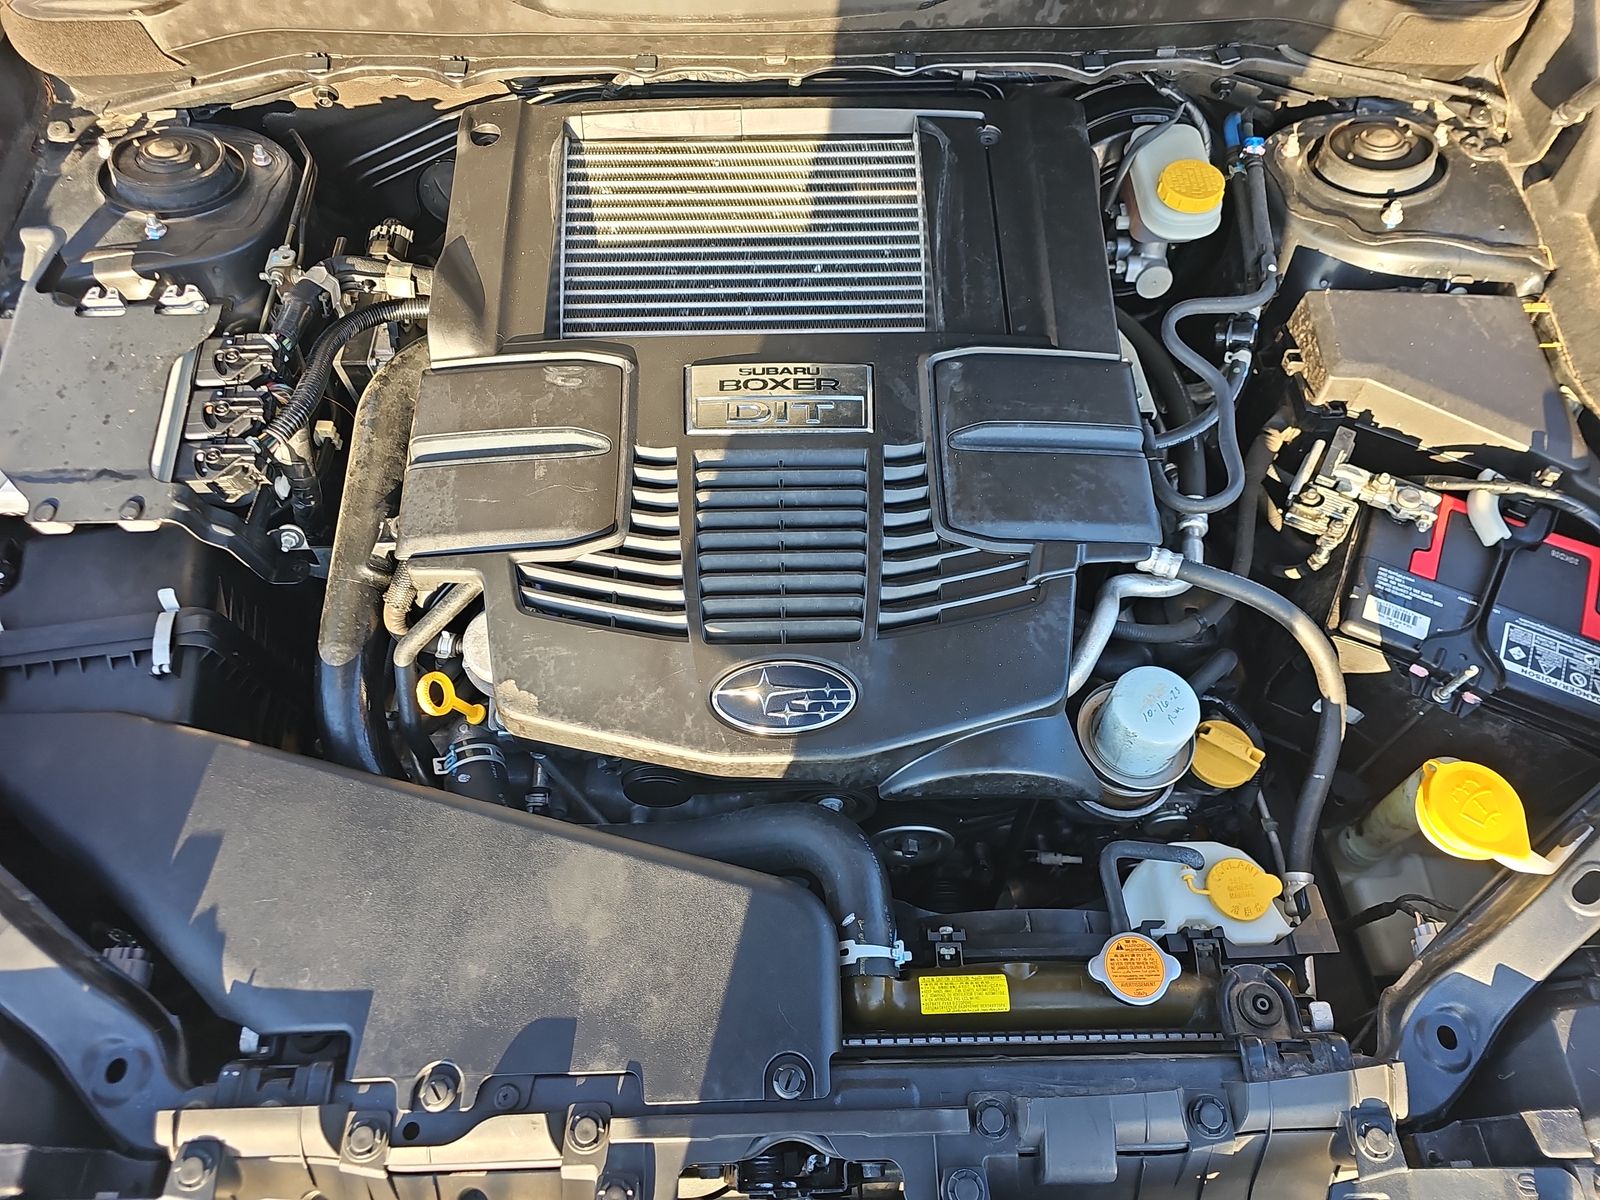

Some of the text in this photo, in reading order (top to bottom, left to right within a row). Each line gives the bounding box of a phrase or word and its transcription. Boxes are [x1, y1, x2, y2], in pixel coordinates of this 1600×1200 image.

[738, 367, 821, 376] SUBARU
[718, 378, 841, 392] BOXER
[726, 401, 835, 425] DIT
[1210, 860, 1260, 882] COOLANT
